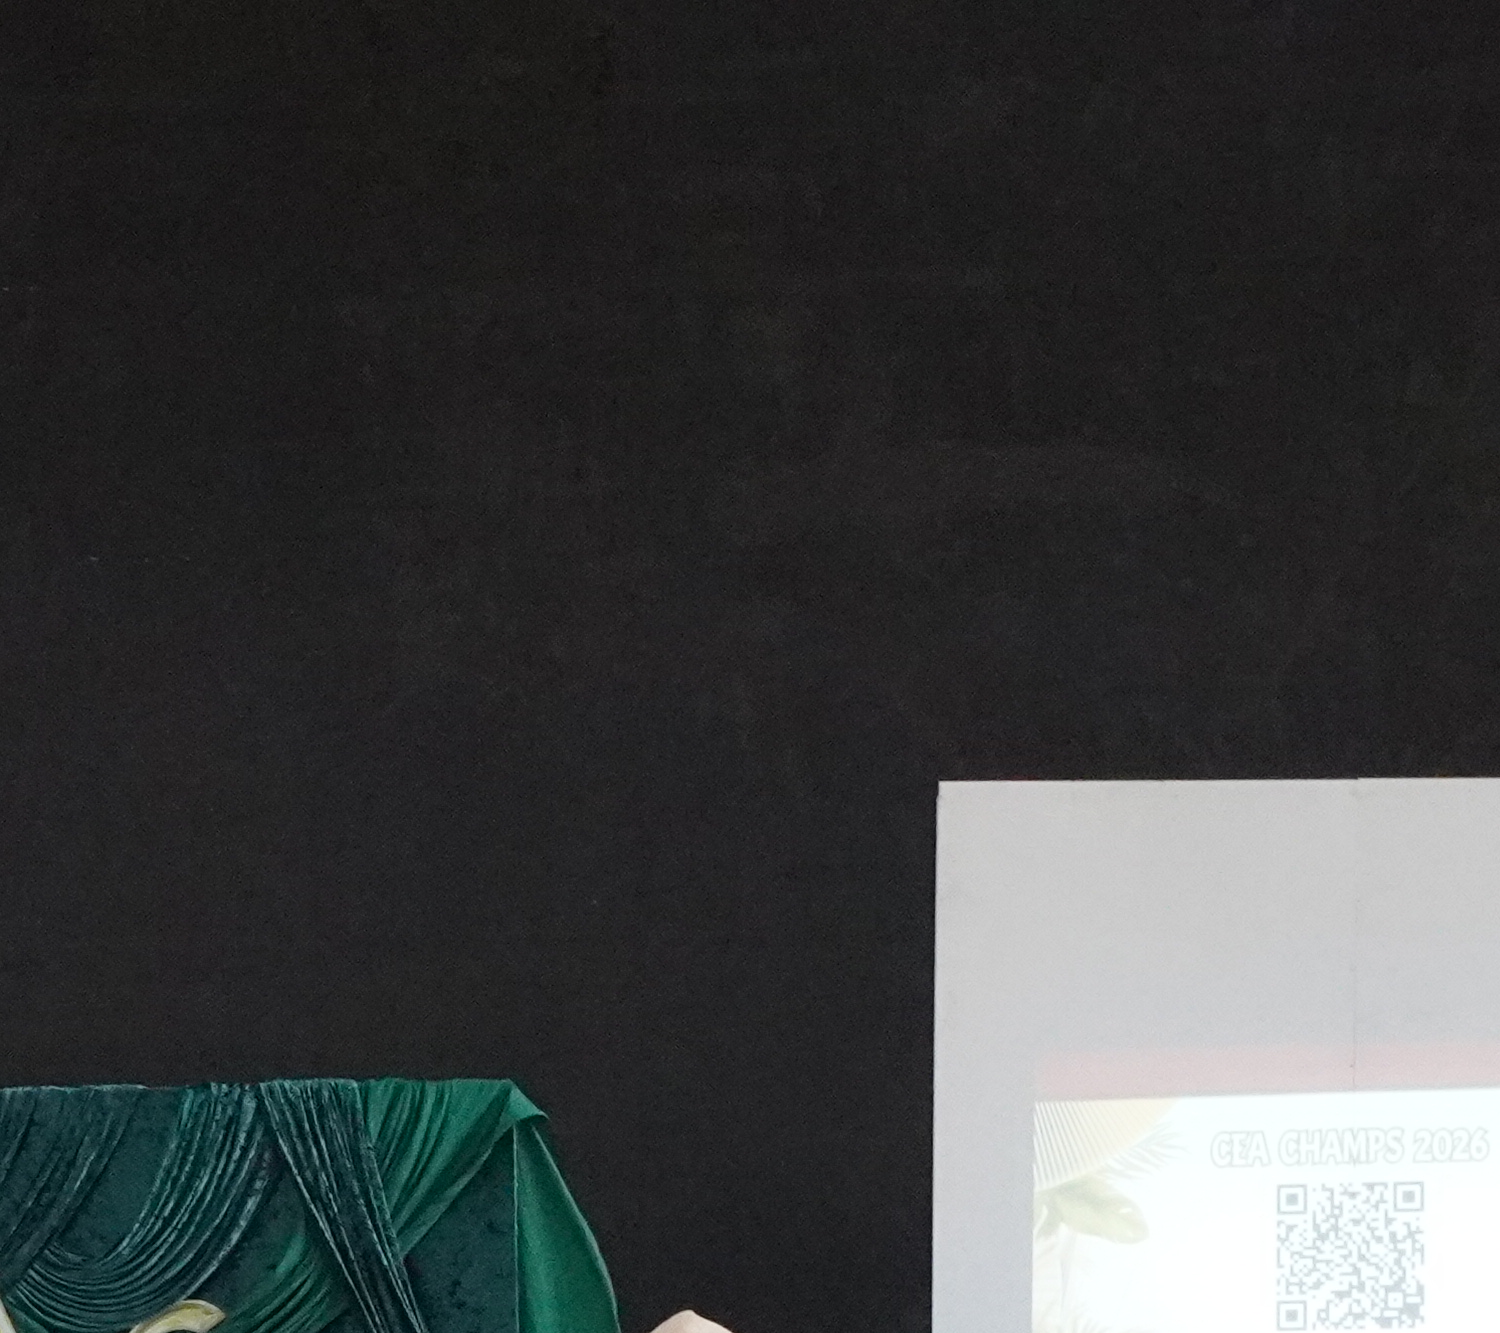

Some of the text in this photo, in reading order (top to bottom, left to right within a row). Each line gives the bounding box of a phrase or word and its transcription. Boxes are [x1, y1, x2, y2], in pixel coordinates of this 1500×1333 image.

[1210, 1126, 1490, 1168] CEA CHAMPS 2026
